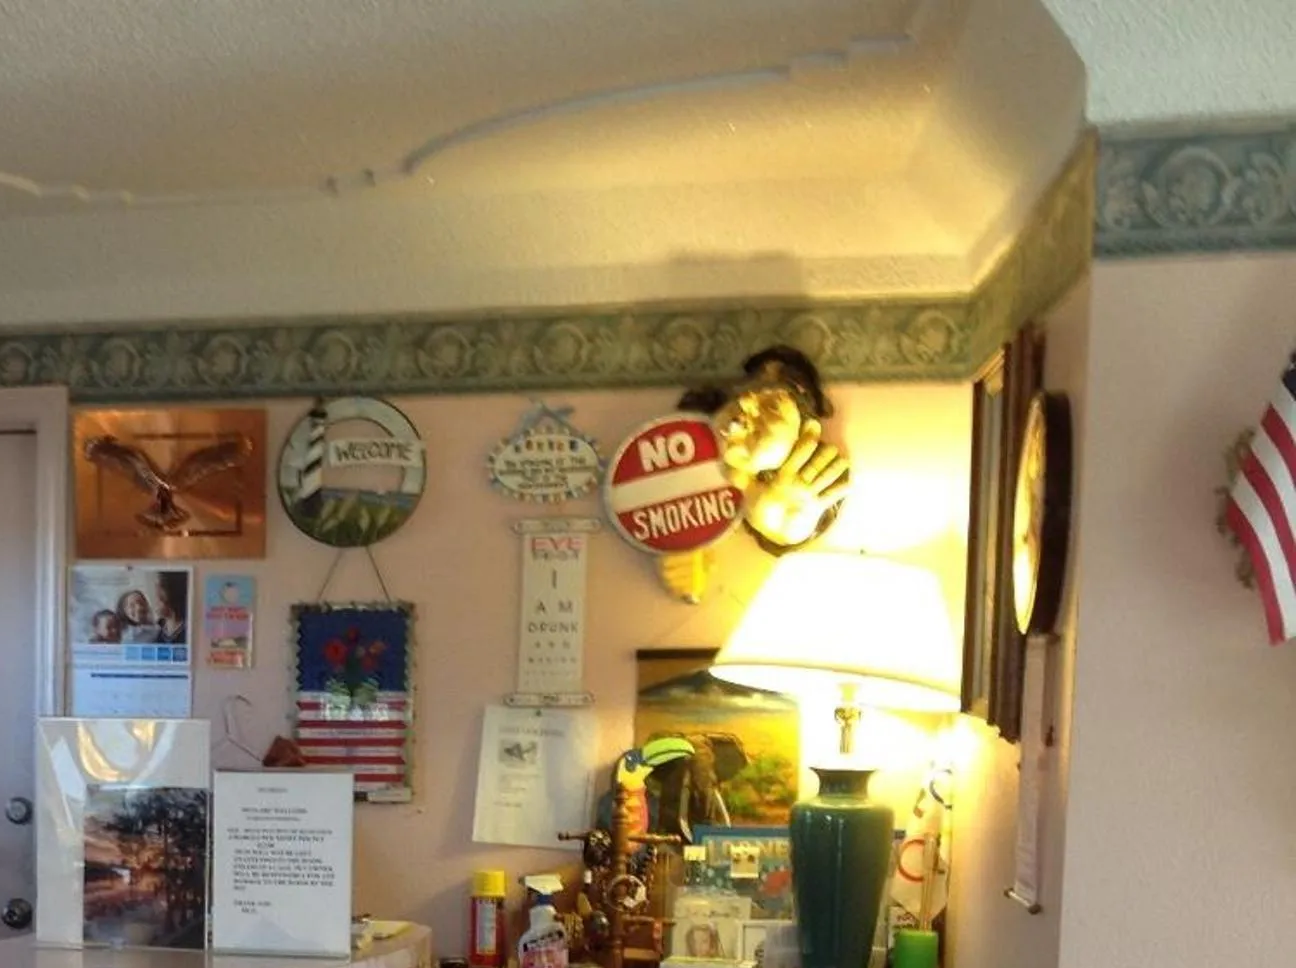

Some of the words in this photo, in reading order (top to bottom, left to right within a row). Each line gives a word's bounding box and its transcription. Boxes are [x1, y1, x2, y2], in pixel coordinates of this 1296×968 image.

[335, 441, 414, 461] WELCOME
[637, 430, 695, 472] NO
[632, 489, 736, 541] SMOKING
[528, 621, 579, 634] DRUNK
